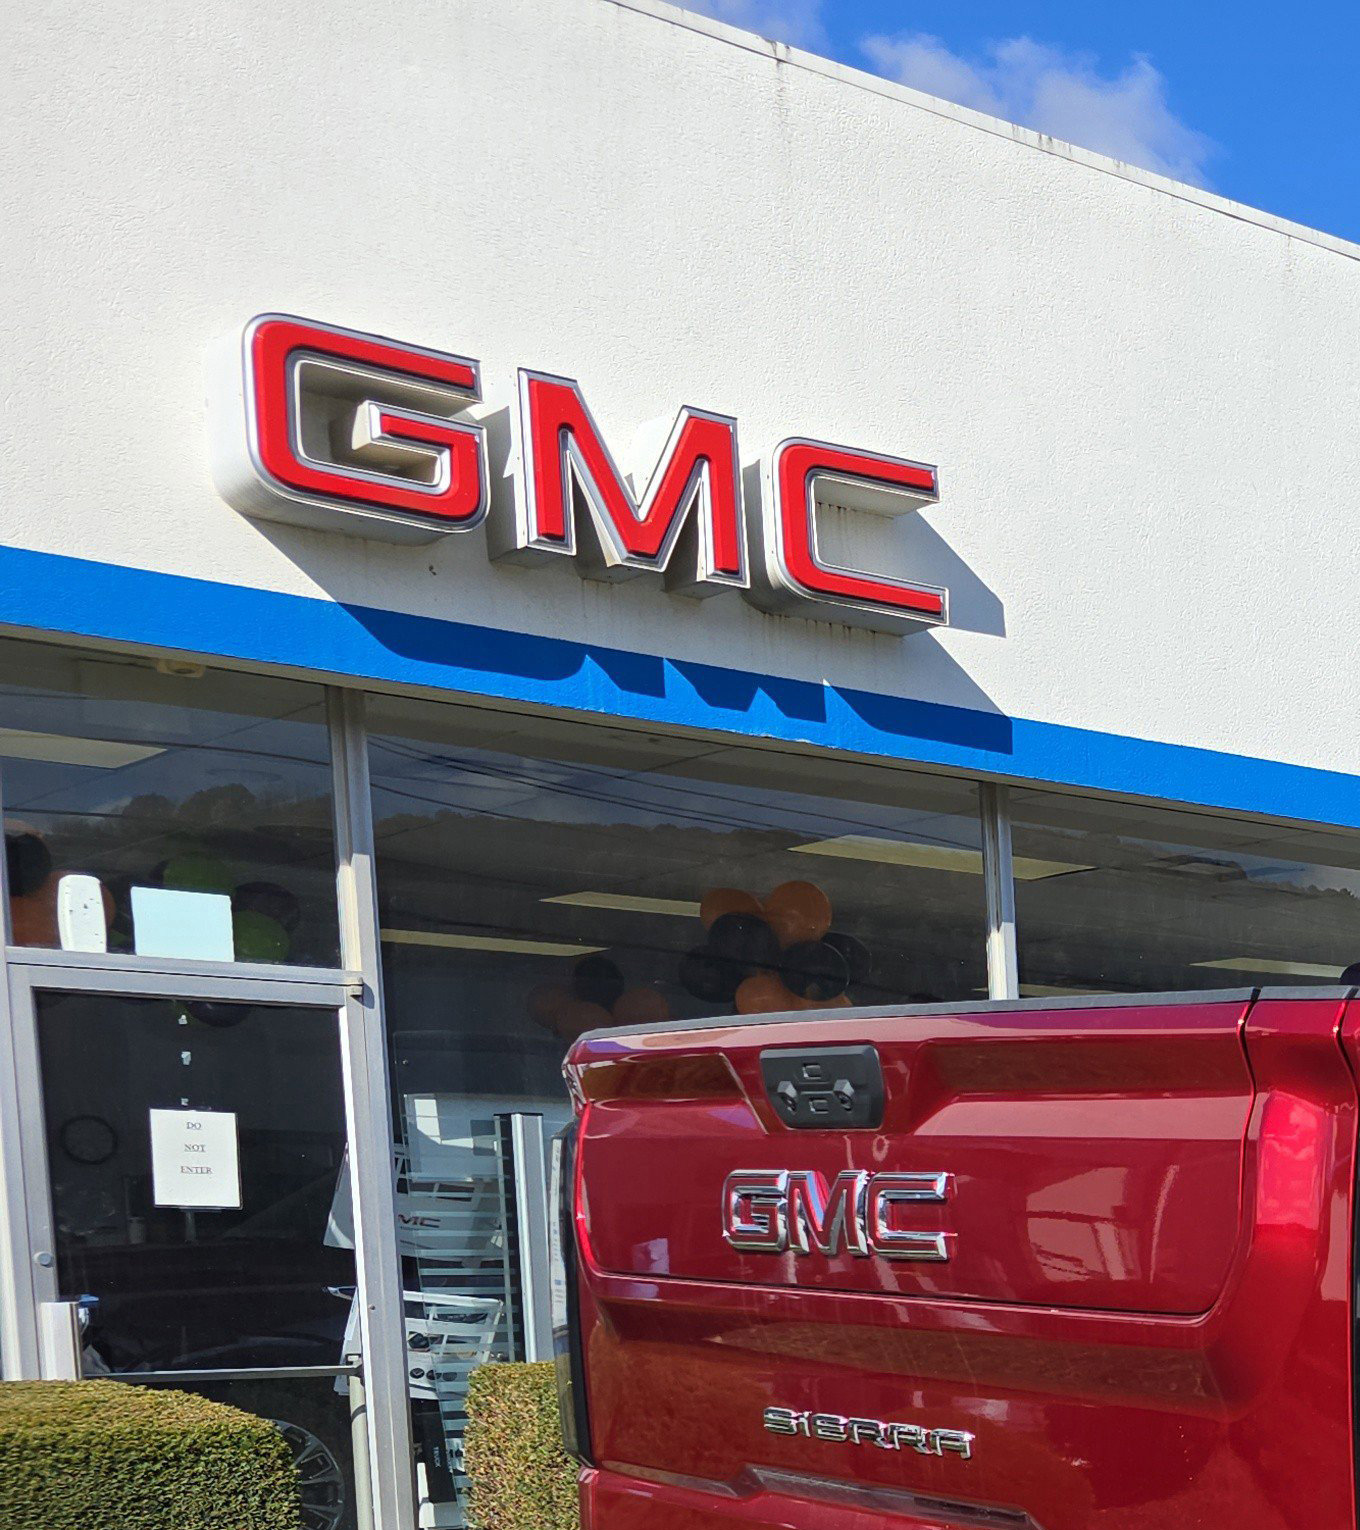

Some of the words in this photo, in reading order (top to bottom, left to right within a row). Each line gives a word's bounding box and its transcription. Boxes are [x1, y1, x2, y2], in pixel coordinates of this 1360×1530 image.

[242, 312, 950, 628] GMC
[186, 1121, 202, 1131] DO
[183, 1143, 206, 1153] NOT
[180, 1165, 213, 1175] ENTER
[398, 1213, 441, 1229] MC
[722, 1168, 952, 1261] GMC
[763, 1406, 975, 1460] SIERRA
